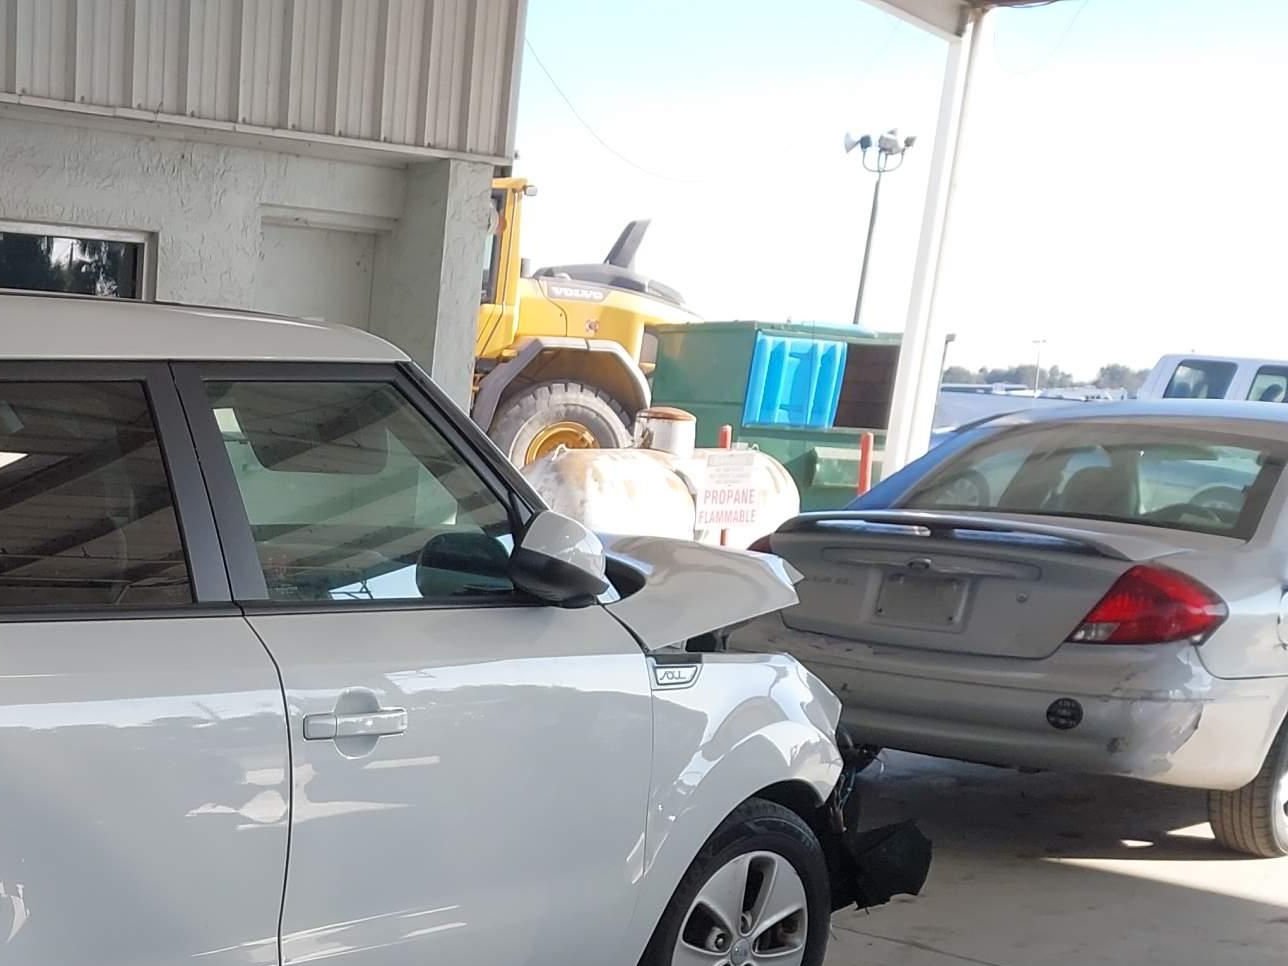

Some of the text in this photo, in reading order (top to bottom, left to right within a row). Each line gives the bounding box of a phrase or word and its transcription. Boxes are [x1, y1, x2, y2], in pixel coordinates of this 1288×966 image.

[551, 286, 604, 300] VOLVO
[703, 488, 756, 505] PROPANE
[697, 508, 756, 525] FLAMMABLE
